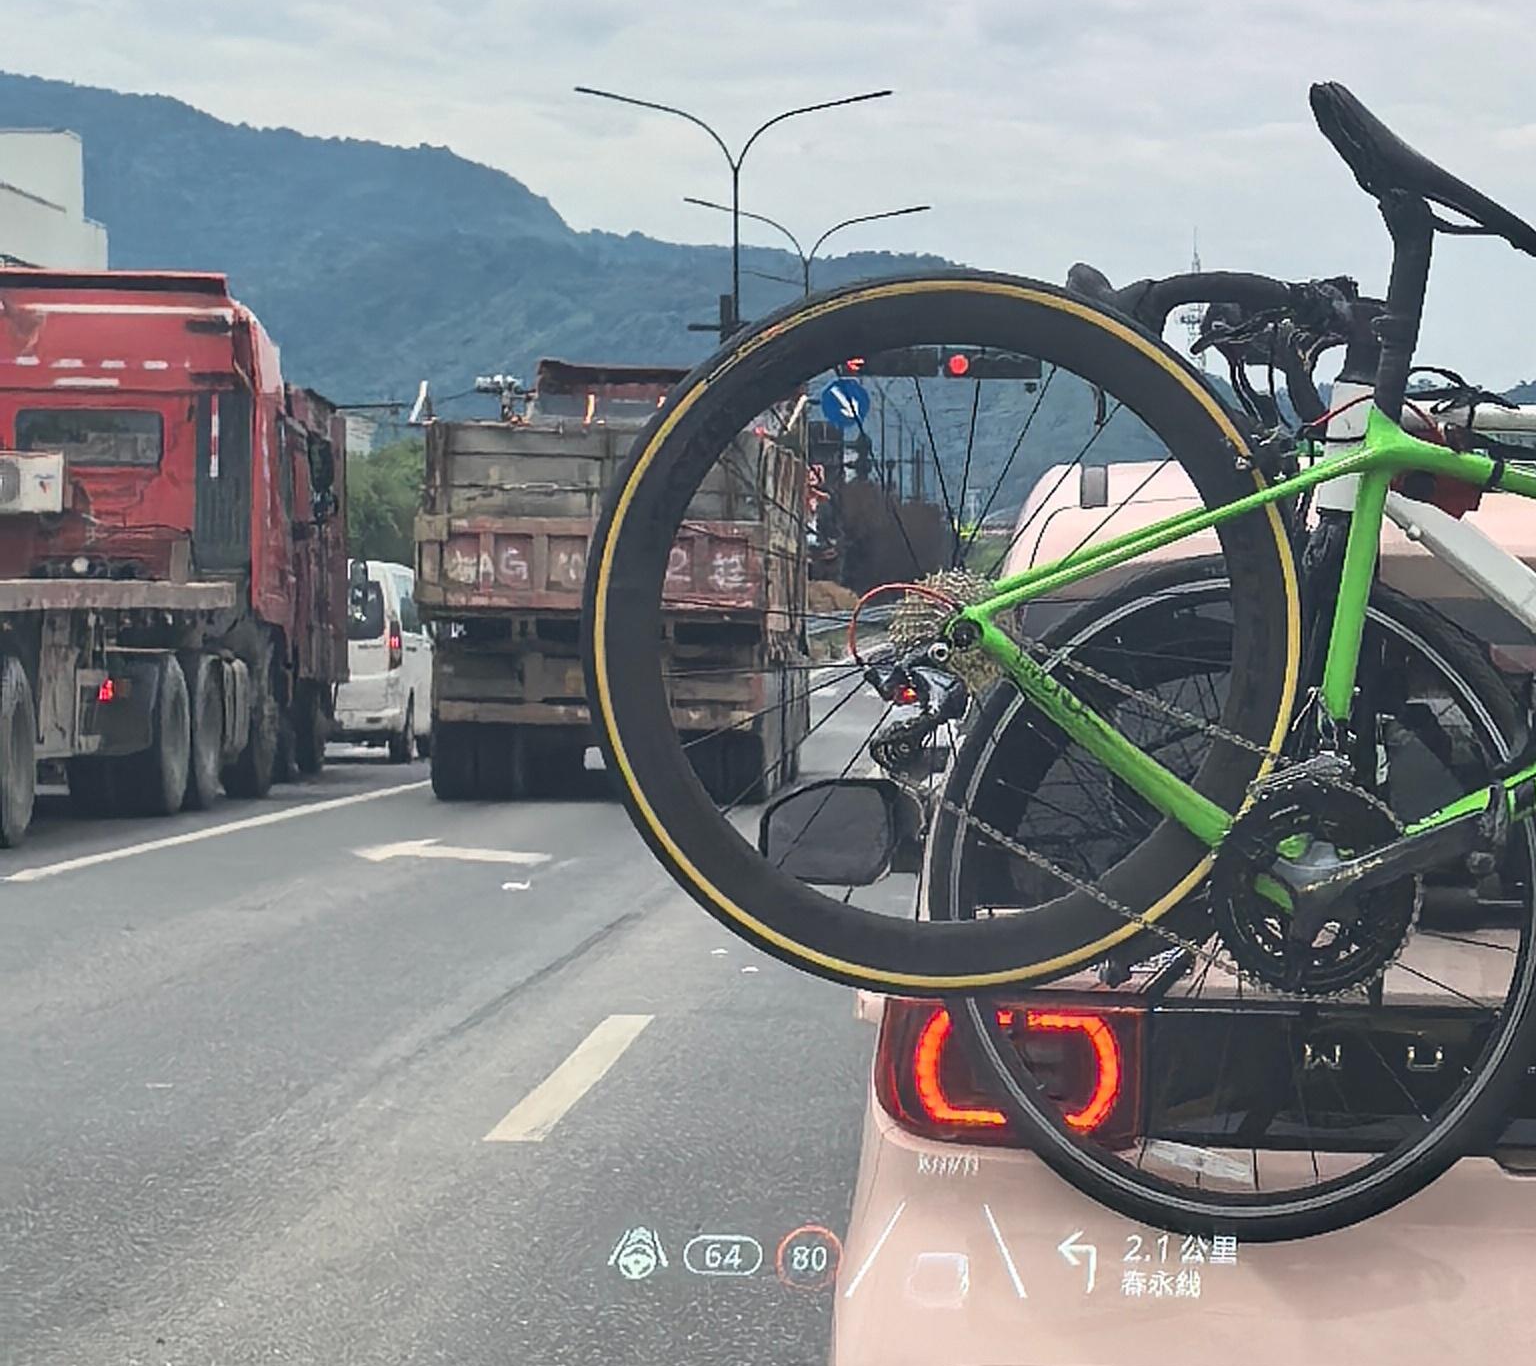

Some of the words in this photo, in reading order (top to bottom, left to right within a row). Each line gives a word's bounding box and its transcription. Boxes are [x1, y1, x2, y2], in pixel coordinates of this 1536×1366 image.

[705, 1244, 742, 1269] 64
[793, 1246, 828, 1271] 80
[1123, 1234, 1169, 1263] 2.1
[1180, 1234, 1237, 1265] 公里
